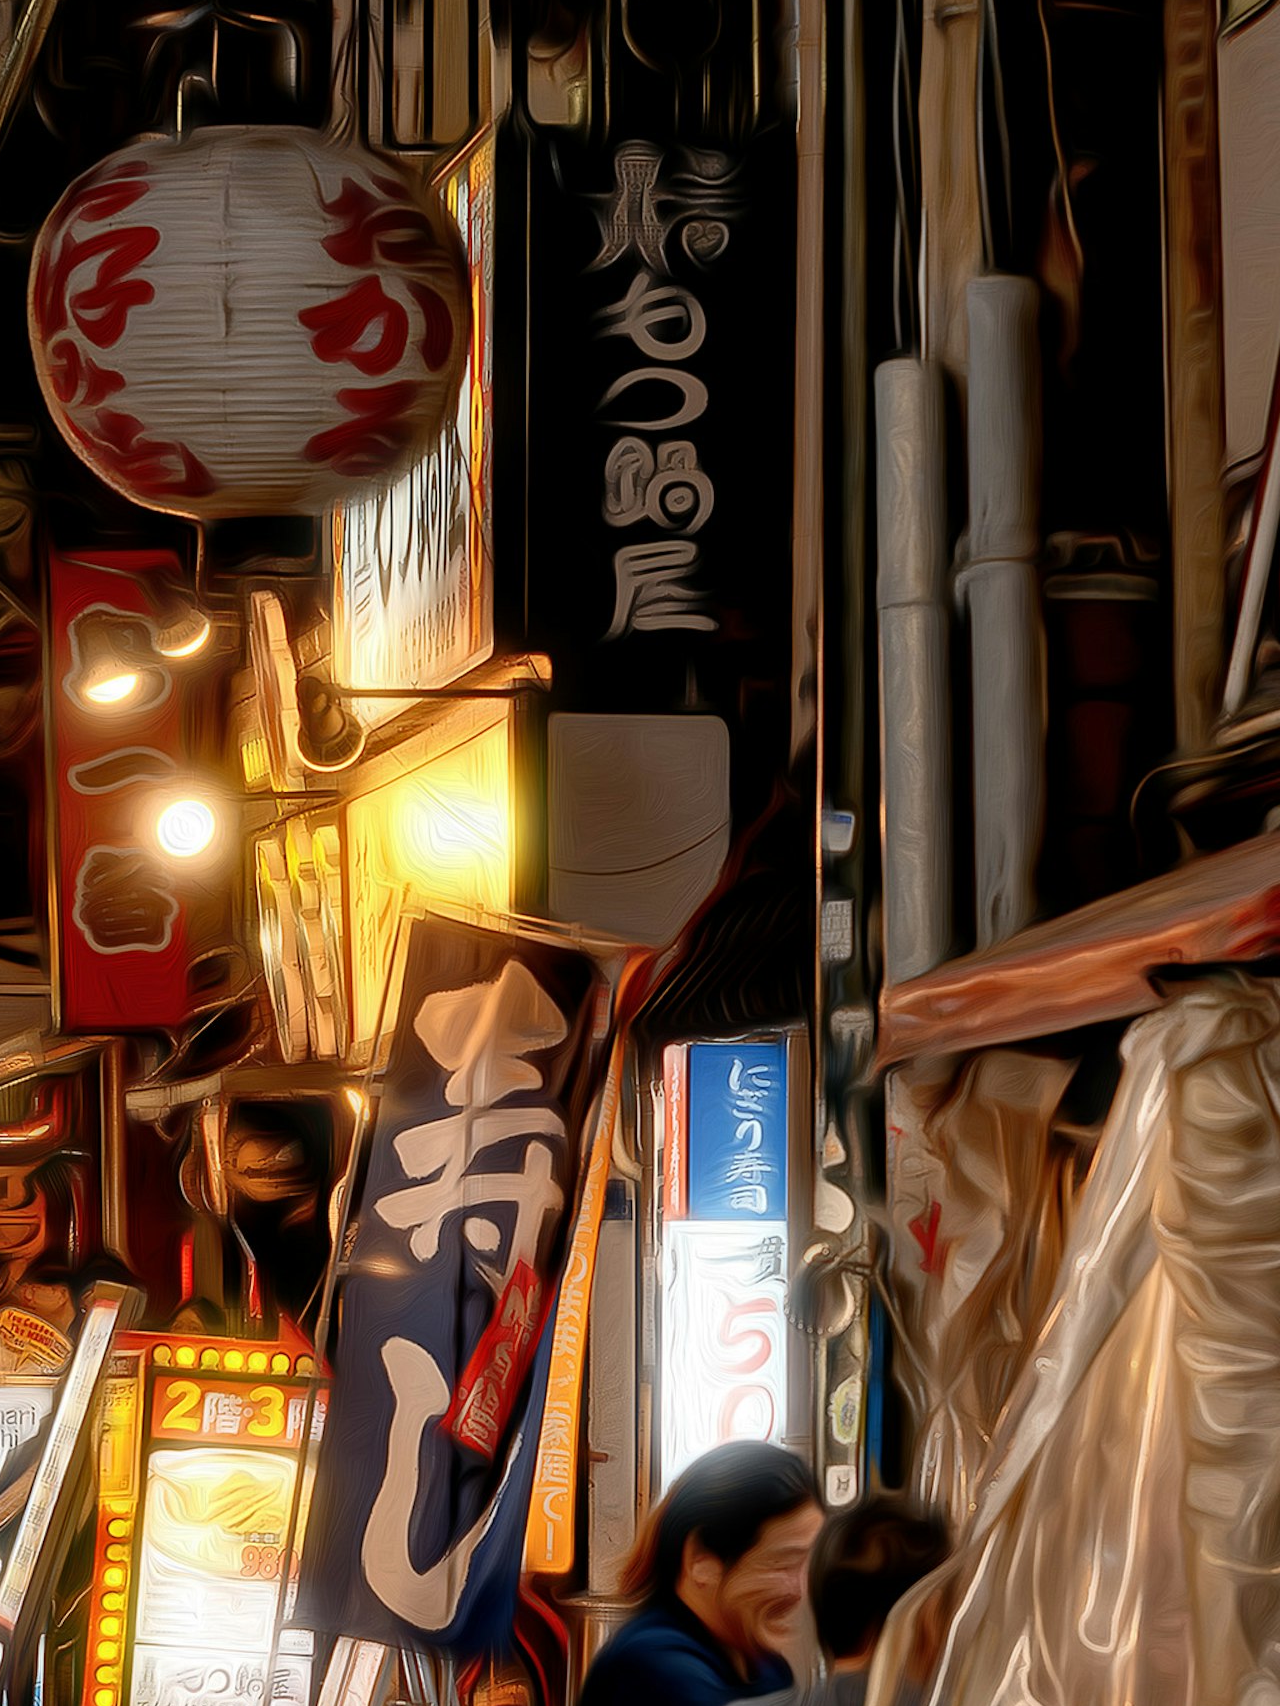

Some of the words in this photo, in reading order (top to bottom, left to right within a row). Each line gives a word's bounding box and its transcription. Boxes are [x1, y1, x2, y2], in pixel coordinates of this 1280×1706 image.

[597, 272, 719, 638] もつ鍋屋
[363, 959, 568, 1633] 寿し
[725, 1058, 771, 1215] にぎり寿司
